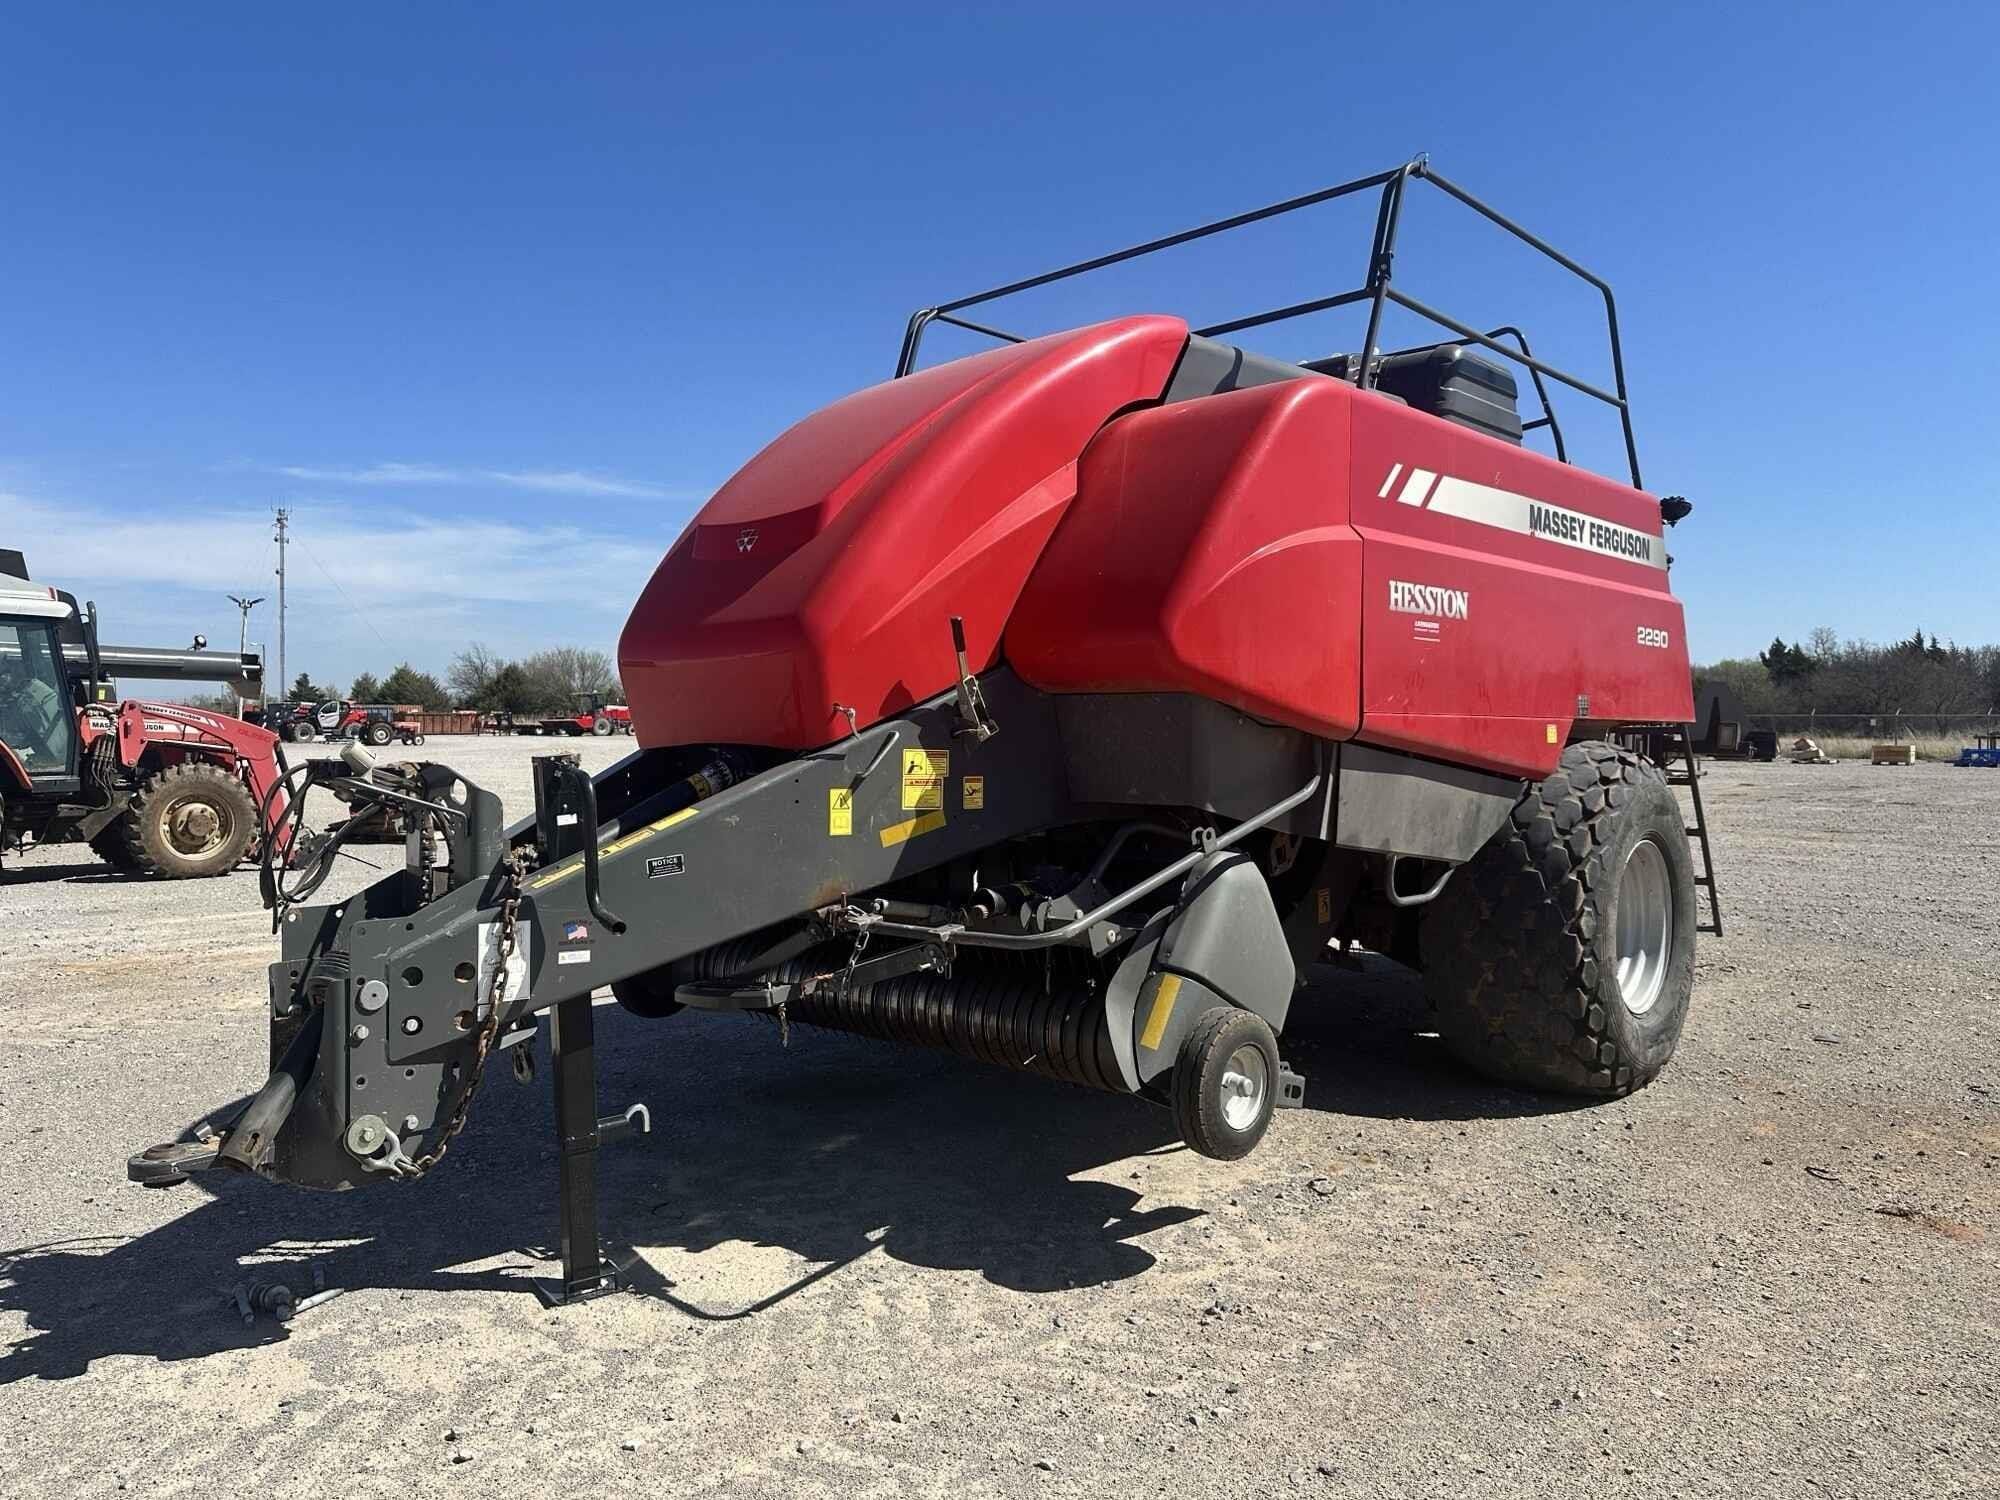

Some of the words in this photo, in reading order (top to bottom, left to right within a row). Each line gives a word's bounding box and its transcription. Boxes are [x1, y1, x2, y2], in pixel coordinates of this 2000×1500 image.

[1529, 504, 1586, 543] MASSEY
[1589, 522, 1650, 561] FERGUSON
[1388, 579, 1469, 620] HESSTON
[1637, 626, 1668, 648] 2290
[652, 857, 677, 867] NOTICE
